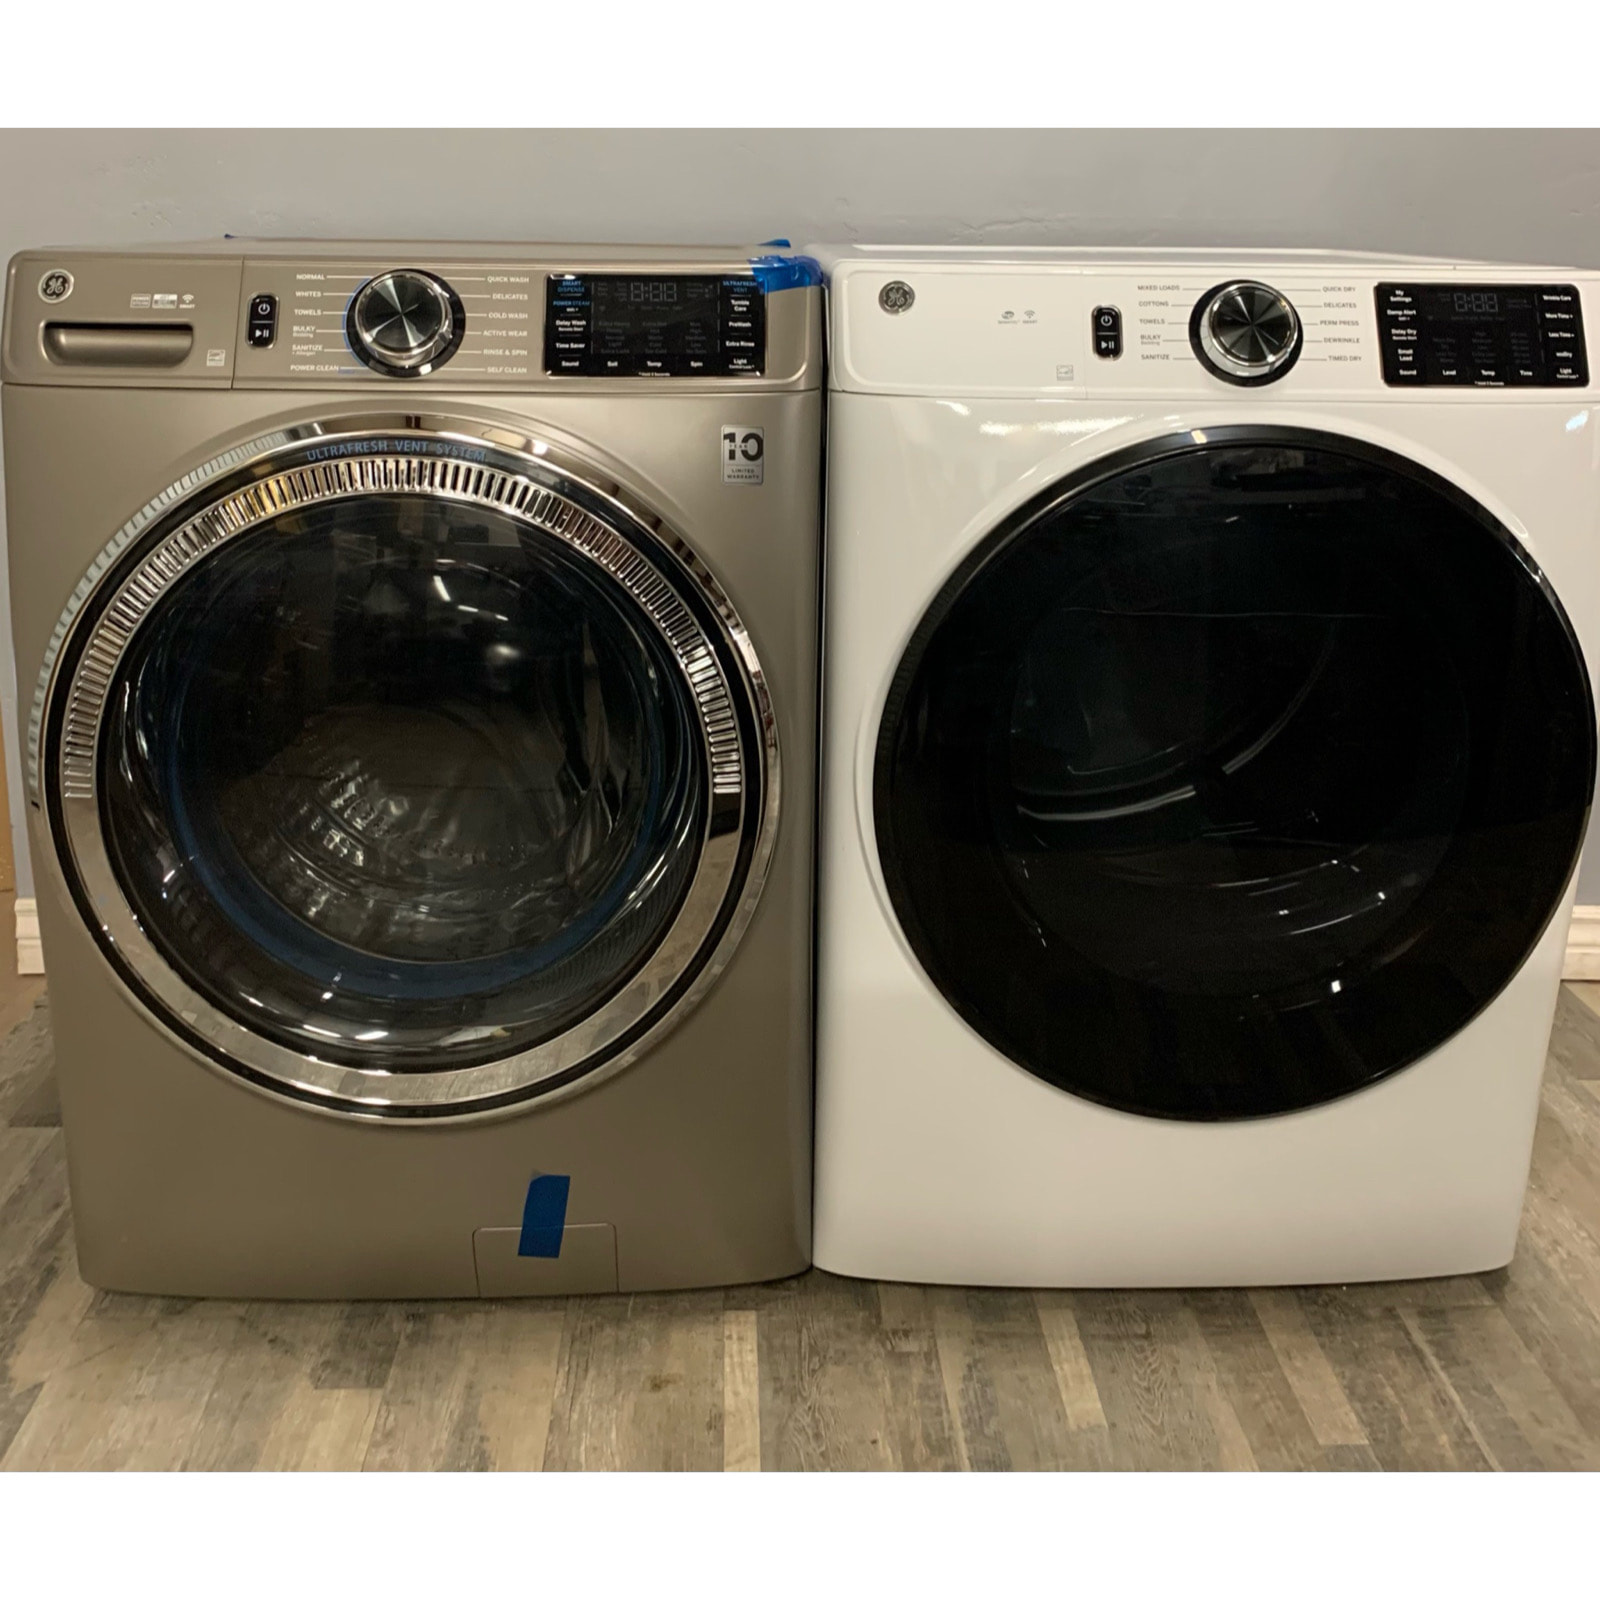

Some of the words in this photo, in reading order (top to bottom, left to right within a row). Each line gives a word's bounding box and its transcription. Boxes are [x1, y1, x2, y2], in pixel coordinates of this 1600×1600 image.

[306, 441, 388, 461] ULTRAFRESH
[395, 440, 429, 453] VENT
[436, 444, 486, 462] SYSTEM
[724, 432, 764, 462] 10
